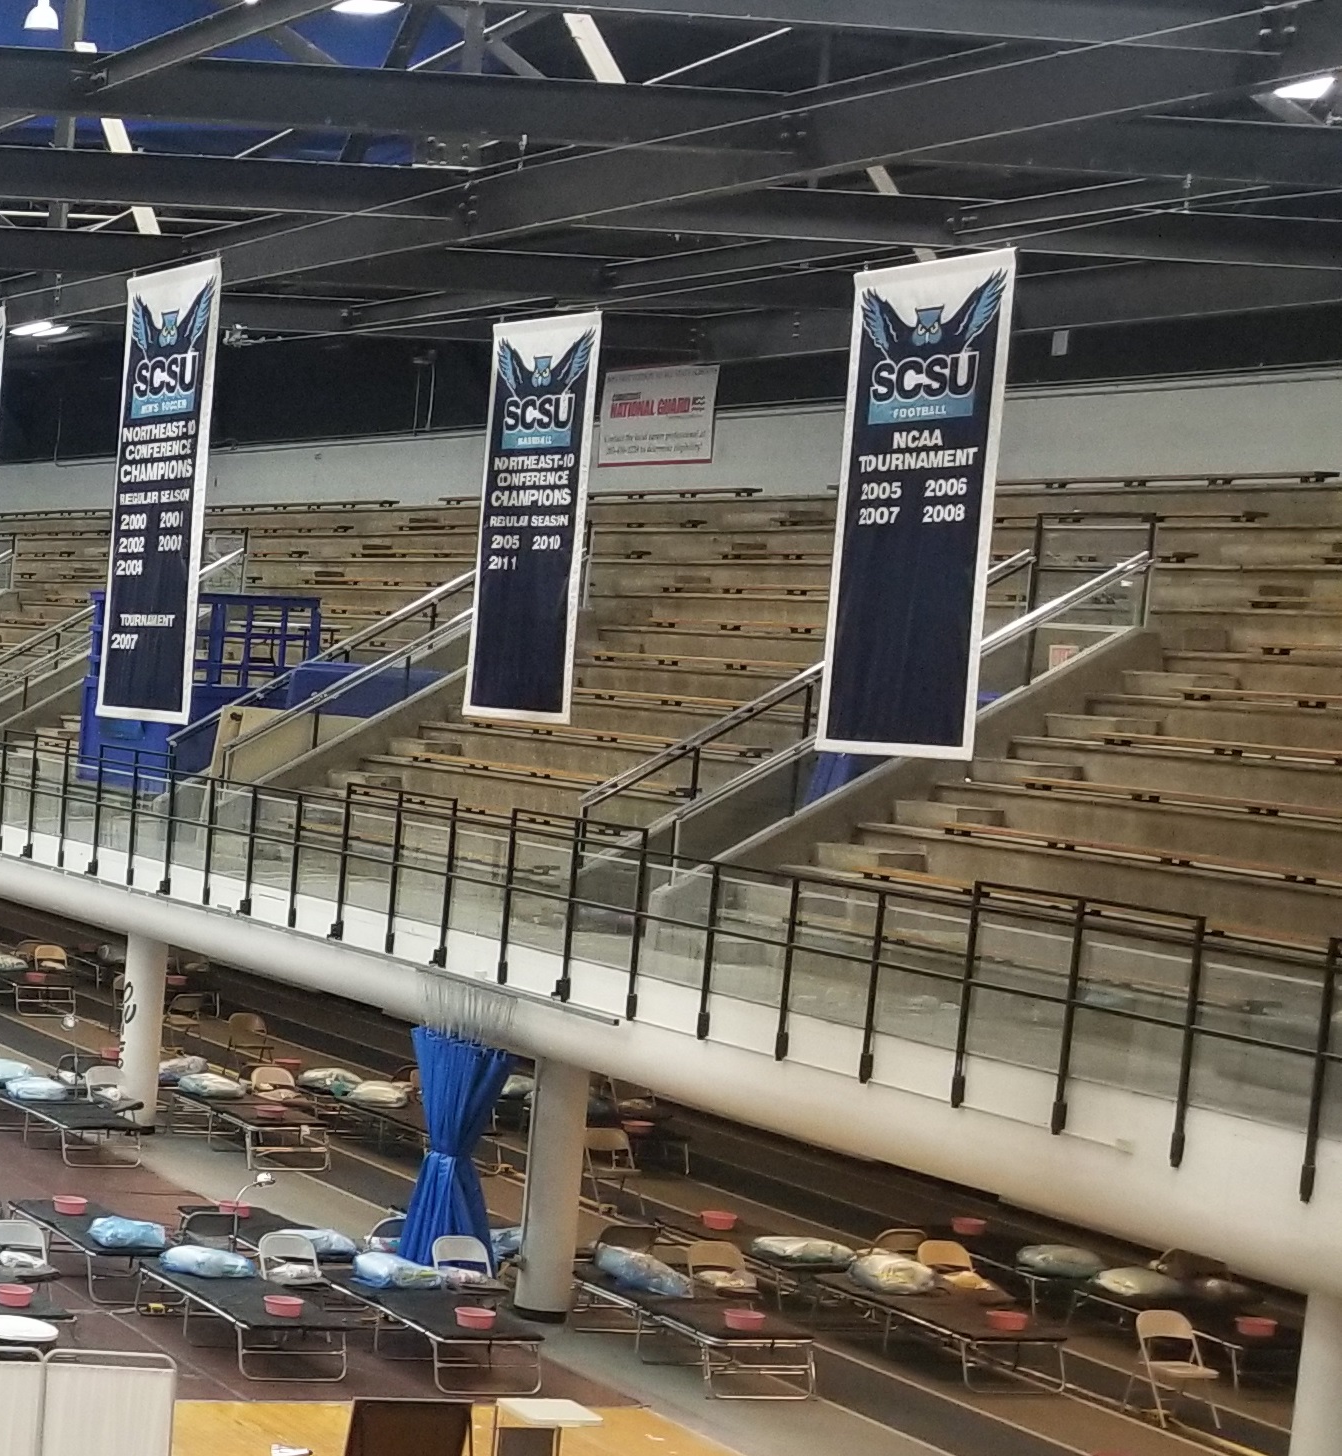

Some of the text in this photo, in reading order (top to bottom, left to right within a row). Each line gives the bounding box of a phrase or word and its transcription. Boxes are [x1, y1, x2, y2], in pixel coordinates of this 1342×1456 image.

[133, 352, 199, 400] SCSU
[870, 351, 979, 404] SCSU
[503, 394, 575, 433] SCSU
[611, 400, 655, 418] NATIONAL
[657, 397, 691, 416] GUARD
[893, 404, 946, 418] FOOTBALL
[123, 420, 195, 442] NORTHEAST-10
[892, 429, 943, 449] NCAA
[126, 439, 192, 460] CONFERENCE
[494, 453, 575, 470] NORTHEAST-10
[858, 447, 979, 473] TOURNAMENT
[121, 459, 193, 483] CHAMPIONS
[497, 470, 569, 487] CONFERENCE
[119, 491, 159, 506] REGULAR
[491, 488, 571, 507] CHAMPIONS
[860, 478, 967, 500] 2005 2006
[120, 513, 147, 530] 2000
[858, 504, 965, 525] 2007 2008
[118, 536, 145, 553] 2002
[491, 534, 561, 550] 2005 2010
[120, 614, 175, 627] TOURNAMENT
[111, 633, 138, 650] 2007
